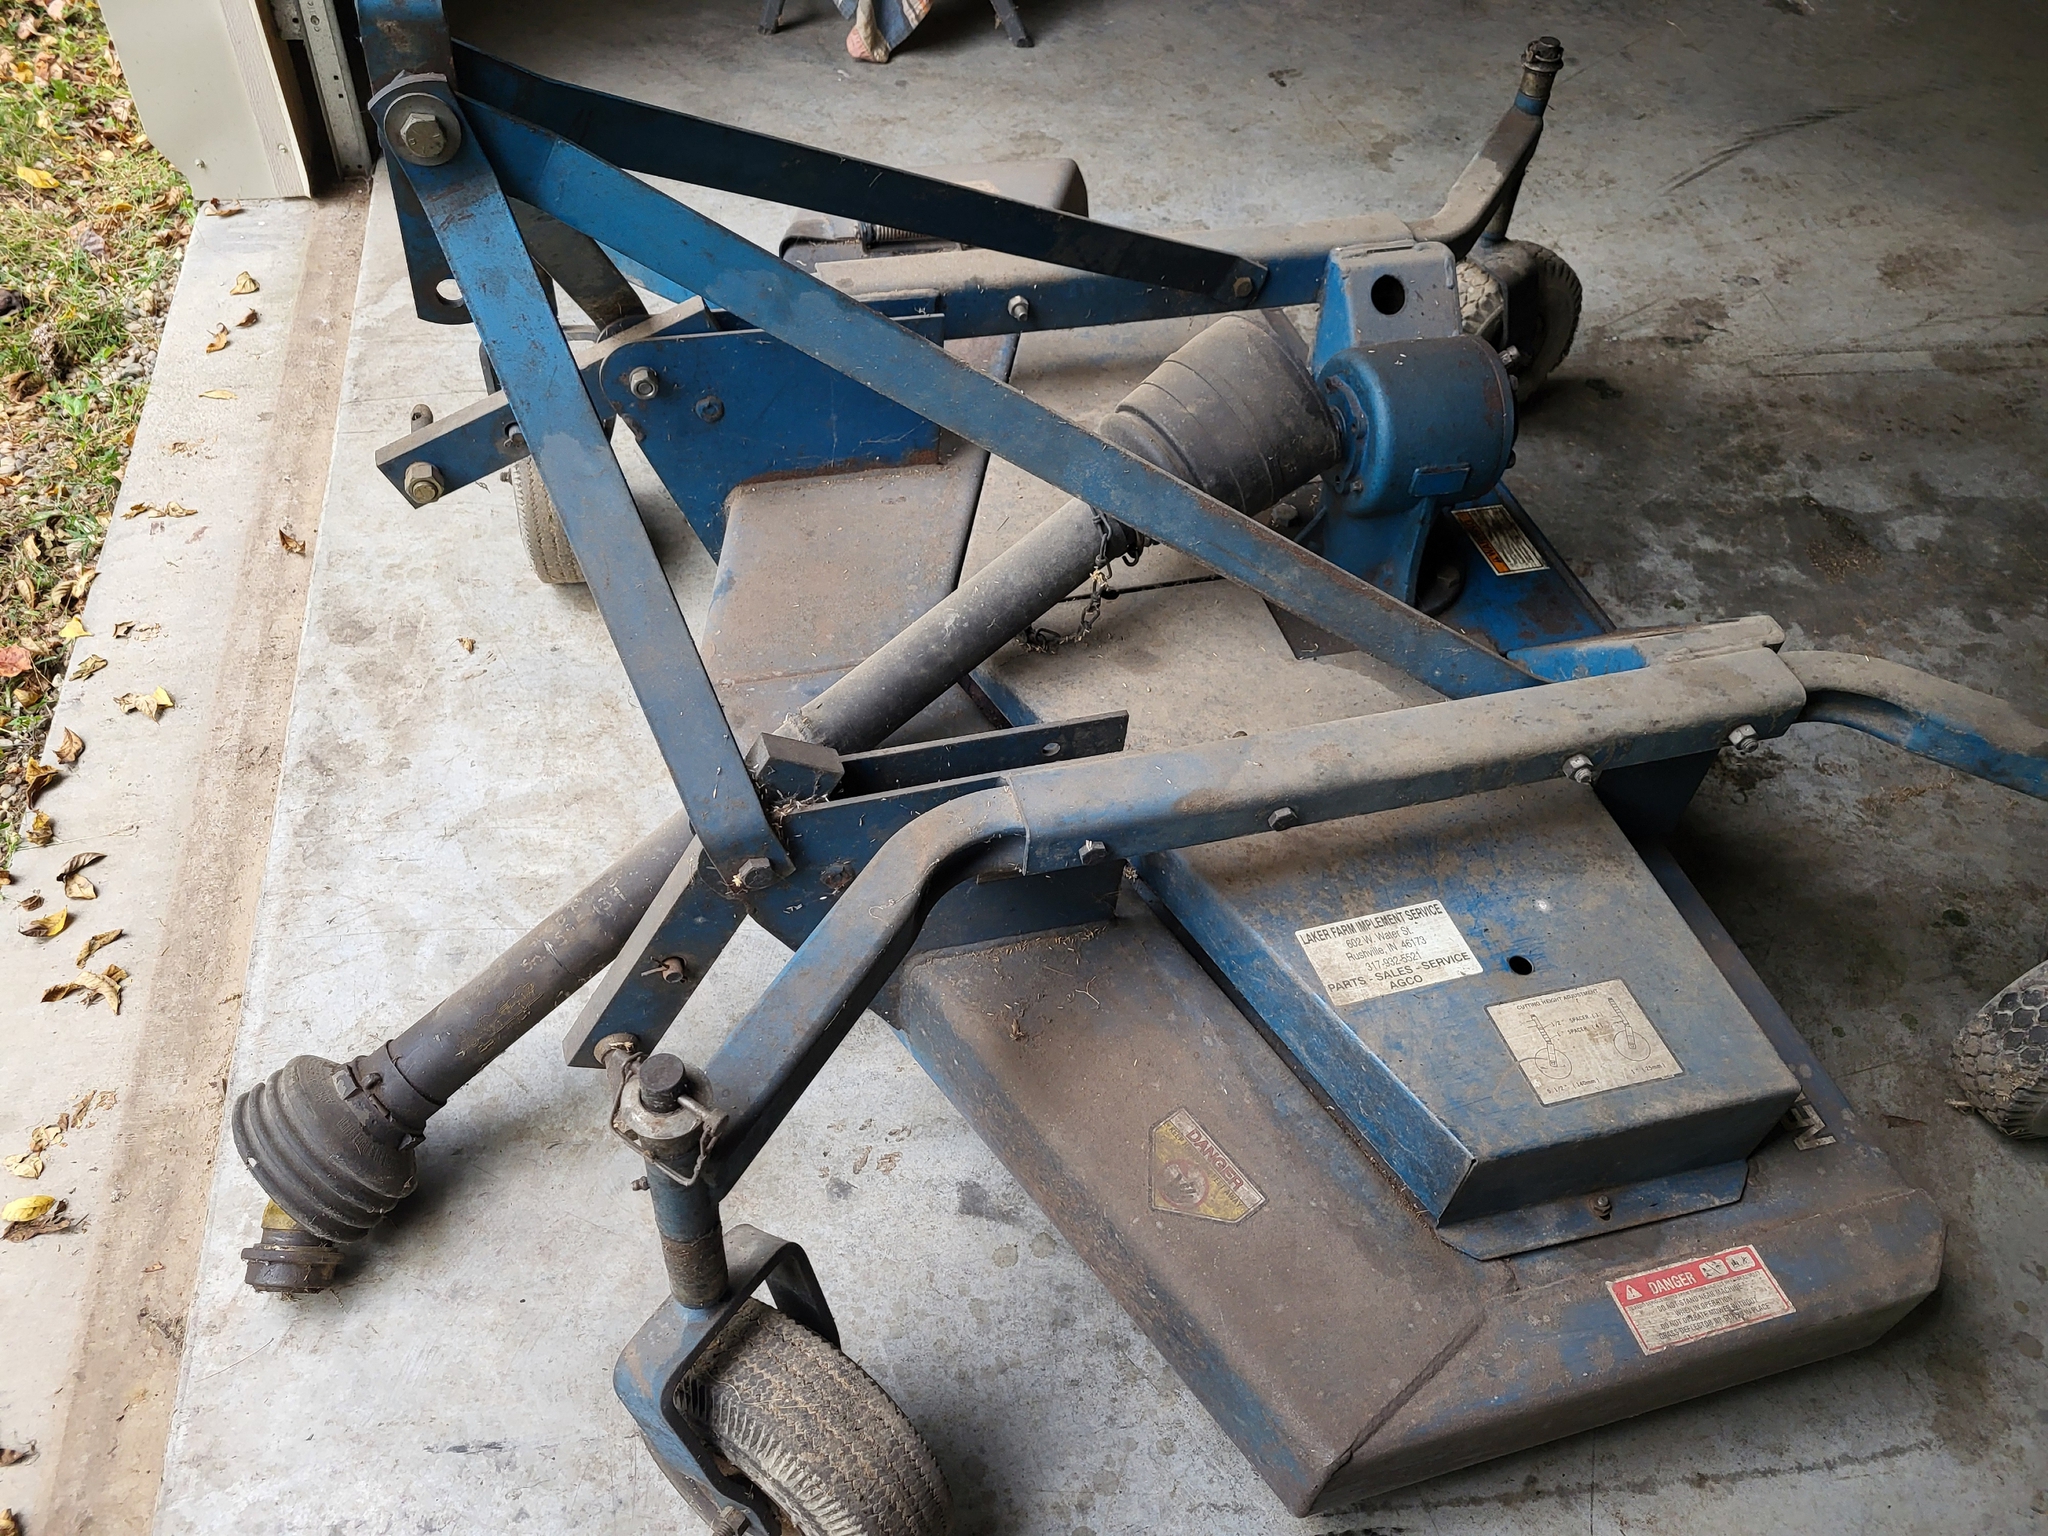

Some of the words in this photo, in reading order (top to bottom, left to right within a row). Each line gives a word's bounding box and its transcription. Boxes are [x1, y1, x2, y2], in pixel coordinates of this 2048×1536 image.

[1299, 929, 1332, 944] LAKER
[1329, 923, 1357, 938] FARM
[1353, 911, 1407, 932] IMPLEMENT
[1402, 903, 1444, 921] SERVICE
[1344, 937, 1363, 948] 602
[1361, 934, 1376, 944] W.
[1374, 928, 1402, 941] Water
[1399, 925, 1414, 935] St.
[1345, 945, 1388, 962] Rushville,
[1385, 942, 1398, 951] IN
[1398, 935, 1427, 949] 46173
[1326, 976, 1367, 992] PARTS
[1373, 964, 1414, 981] SALES
[1419, 951, 1471, 970] SERVICE
[1363, 950, 1423, 971] 317-932-5521
[1386, 973, 1424, 989] AGCO
[1515, 1000, 1541, 1010] CUTTING
[1540, 996, 1562, 1004] HEIGHT
[1561, 988, 1599, 1000] ADJUSTMENT
[1568, 1014, 1589, 1022] SPACER
[1566, 1026, 1588, 1034] SPACER
[1183, 1128, 1245, 1191] DANGER
[1223, 1188, 1243, 1208] AWAY
[1646, 1271, 1697, 1294] DANGER
[1655, 1304, 1667, 1312] DO
[1665, 1300, 1679, 1309] NOT
[1677, 1295, 1699, 1306] STAND
[1697, 1290, 1716, 1300] NEAR
[1714, 1282, 1743, 1296] MACHINE
[1673, 1306, 1693, 1316] WHEN
[1699, 1295, 1733, 1309] OPERATION
[1658, 1329, 1679, 1339] GRASS
[1678, 1318, 1714, 1334] DEFLECTOR
[1750, 1302, 1771, 1313] PLACE
[1659, 1321, 1670, 1329] DO
[1668, 1318, 1683, 1327] NOT
